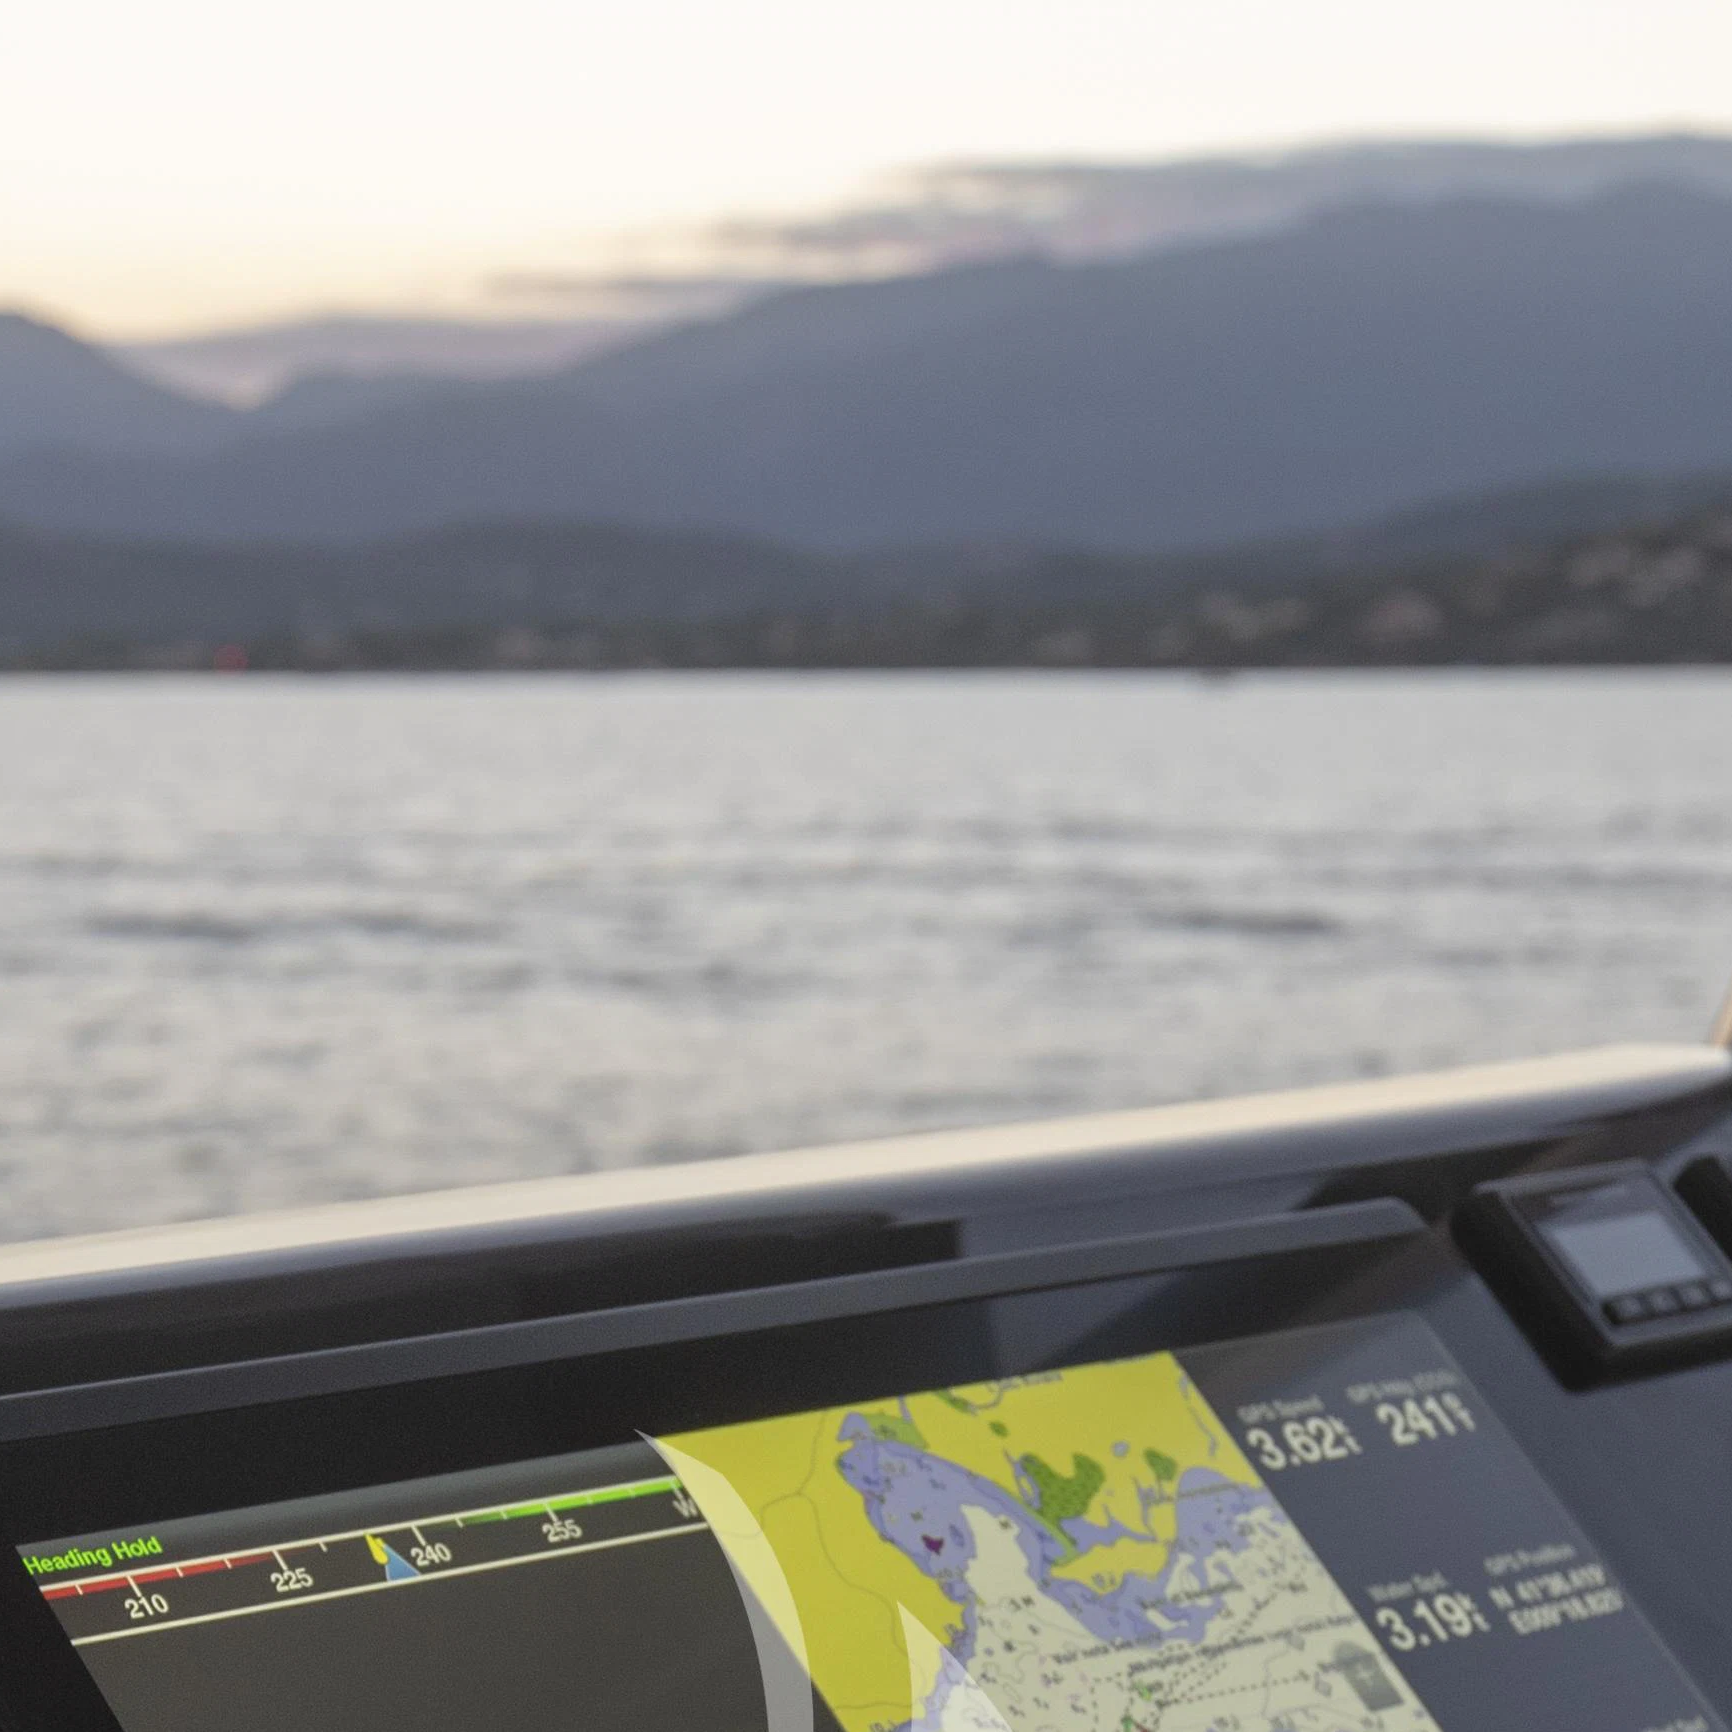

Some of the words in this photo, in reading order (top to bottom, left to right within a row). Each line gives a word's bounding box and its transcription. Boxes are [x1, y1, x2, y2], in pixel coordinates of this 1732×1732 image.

[542, 1517, 583, 1543] 255
[23, 1545, 109, 1577] Heading
[112, 1536, 163, 1563] Hold
[410, 1542, 452, 1568] 240
[270, 1567, 313, 1593] 225
[124, 1593, 169, 1619] 210
